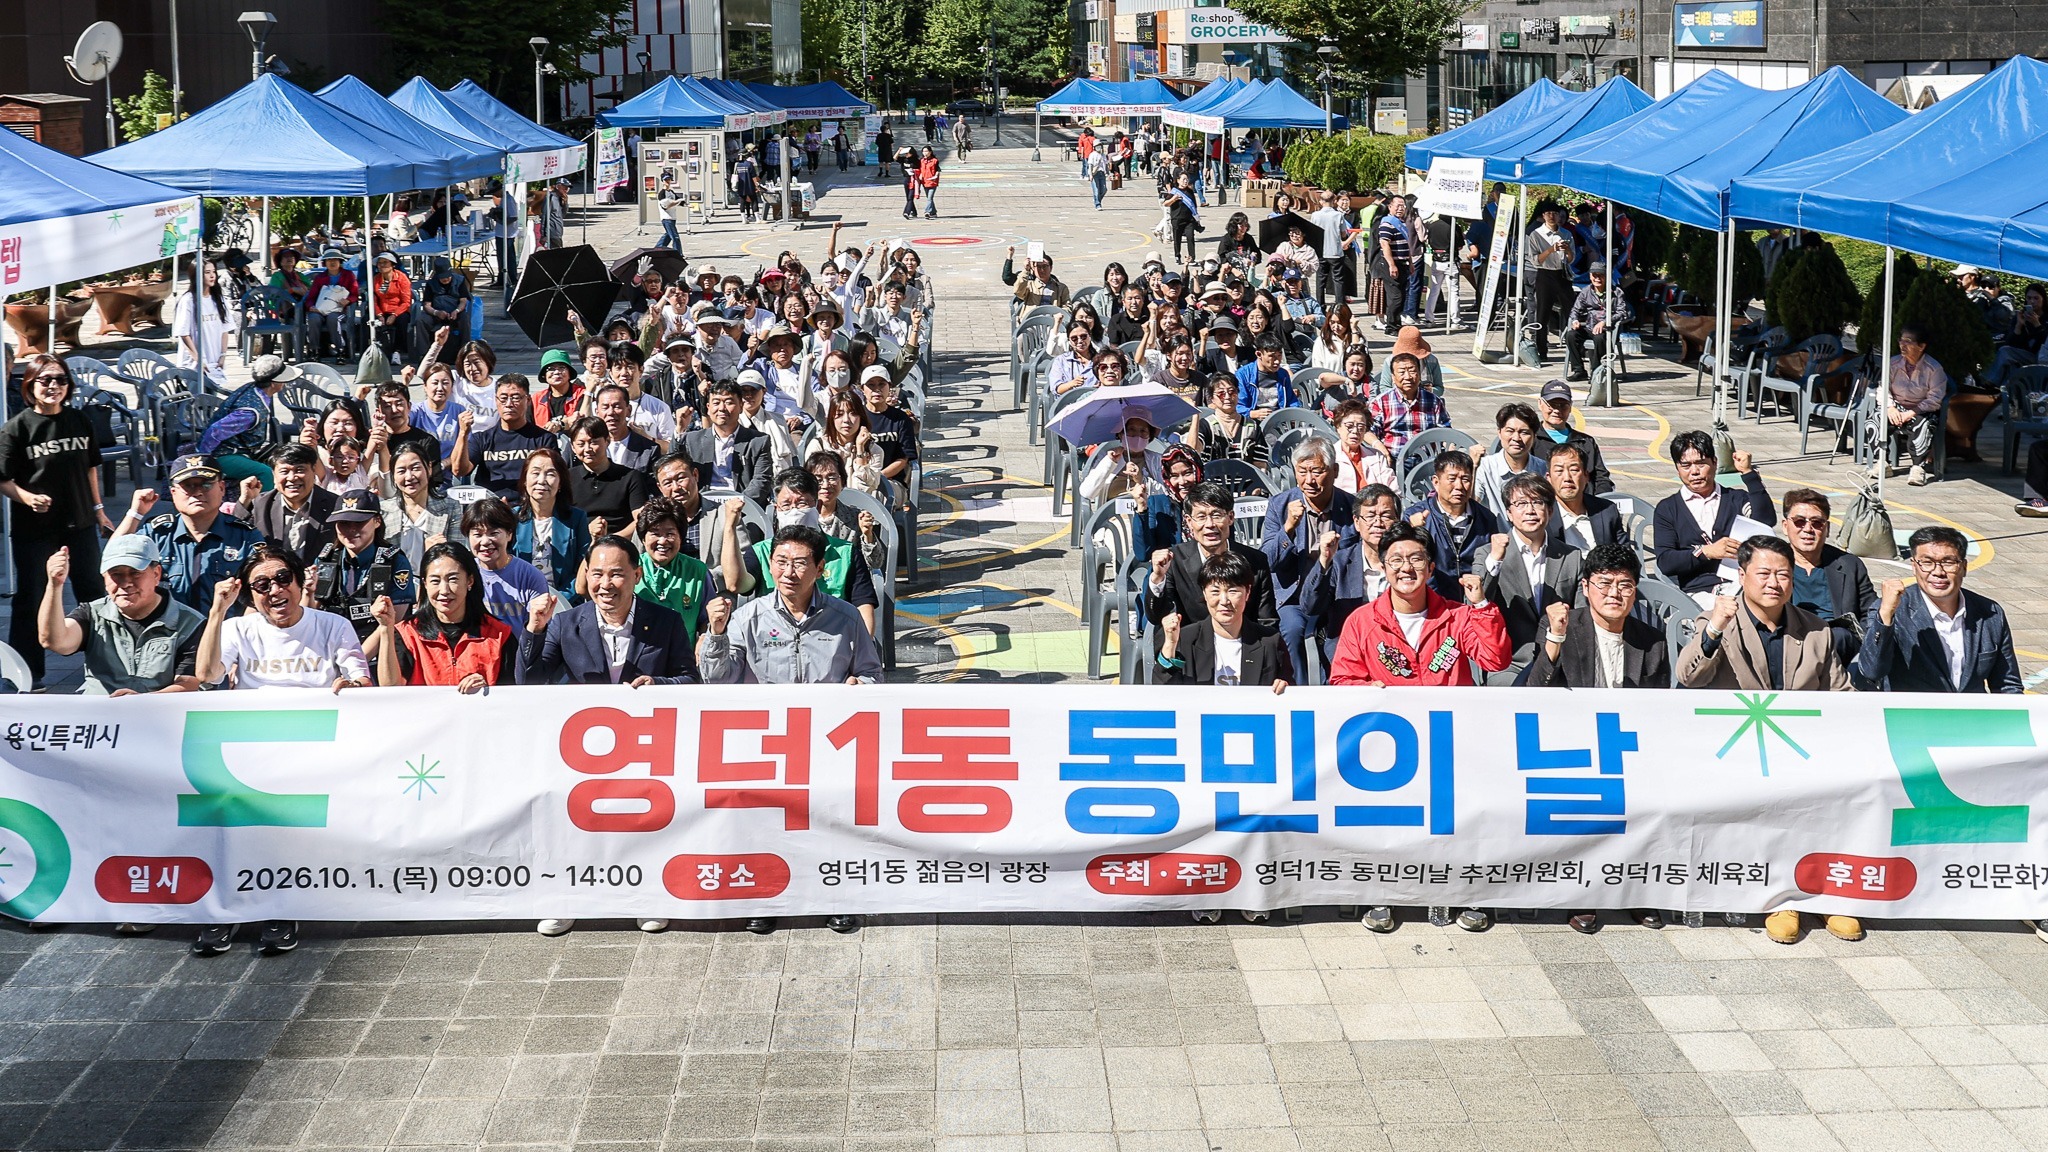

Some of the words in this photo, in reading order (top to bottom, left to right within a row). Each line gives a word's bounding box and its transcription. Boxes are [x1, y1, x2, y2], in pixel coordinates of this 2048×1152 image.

[1191, 14, 1234, 25] Re:shop
[1191, 26, 1268, 37] GROCERY
[1070, 106, 1096, 114] 영덕1동
[26, 437, 89, 459] INSTAY
[458, 492, 475, 501] 내빈
[1239, 504, 1267, 514] 체육회장
[245, 656, 323, 674] INSTAY
[4, 722, 120, 751] 용인특례시
[559, 707, 1019, 833] 영덕1동
[1059, 709, 1455, 836] 동민의
[1514, 712, 1639, 836] 날
[237, 867, 357, 892] 2026.10.
[365, 868, 384, 889] 1.
[393, 866, 438, 893] (목)
[448, 865, 531, 888] 09:00
[566, 864, 643, 887] 14:00
[818, 860, 908, 885] 영덕1동
[916, 860, 990, 884] 젊음의
[1000, 861, 1050, 884] 광장
[1256, 860, 1343, 885] 영덕1동
[1351, 862, 1452, 885] 동민의날
[1460, 861, 1591, 888] 추진위원회,
[1602, 862, 1687, 885] 영덕1동
[1697, 861, 1770, 887] 체육회
